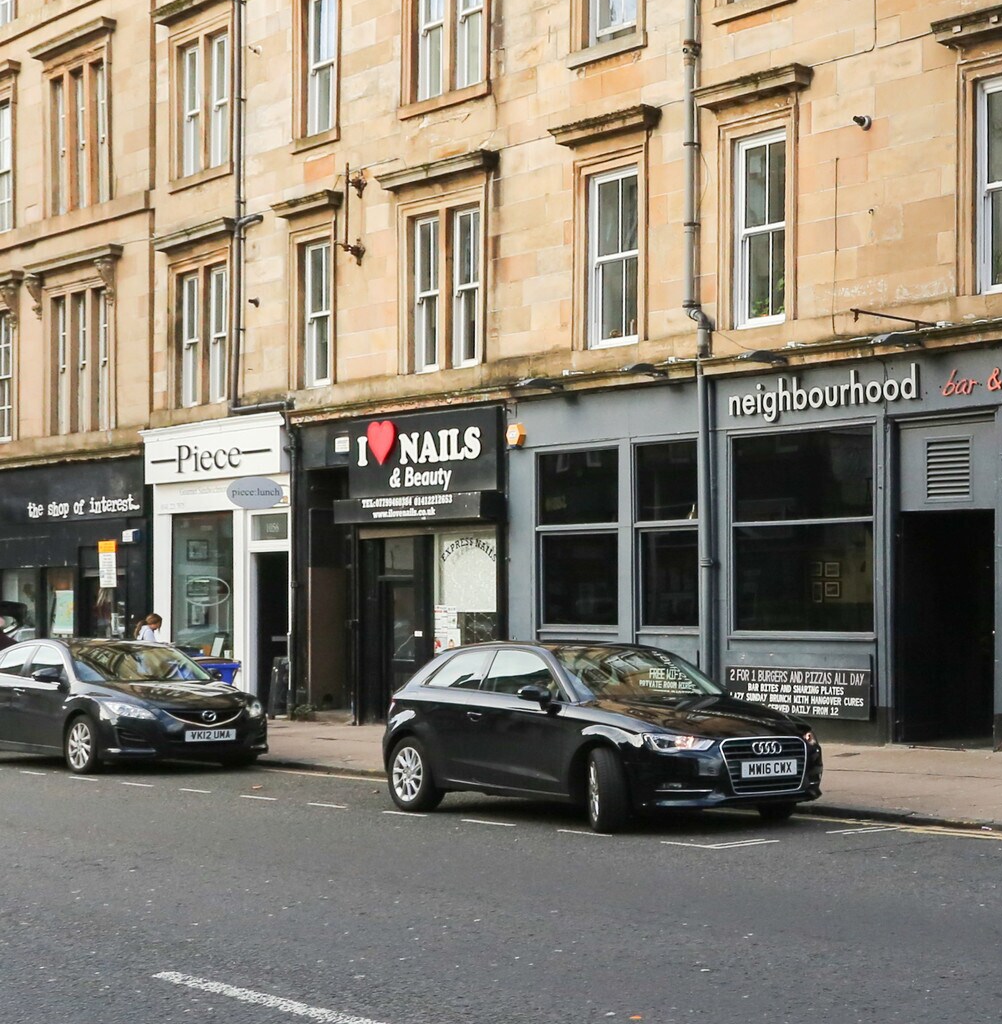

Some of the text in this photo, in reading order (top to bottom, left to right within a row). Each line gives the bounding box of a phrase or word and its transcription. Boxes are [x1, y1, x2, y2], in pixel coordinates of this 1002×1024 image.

[728, 363, 919, 422] neighbourhood
[941, 368, 979, 397] bar
[986, 367, 1002, 391] &
[357, 426, 482, 467] I NAILS
[175, 444, 241, 474] Piece
[389, 466, 453, 492] & Beauty
[231, 487, 280, 499] piece:lunch
[27, 502, 44, 518] the
[47, 501, 70, 519] shop
[73, 499, 86, 515] of
[440, 537, 496, 562] EXPRESS NAILS
[649, 667, 666, 680] FREE
[730, 669, 865, 686] 2 FOR 1 BURGERS AND PIZZAS ALL DAY
[747, 682, 844, 696] BAR BITES AND SHARING PLATES
[746, 692, 767, 702] SUNDAY
[769, 693, 792, 704] BRUNCH
[793, 695, 809, 705] WITH
[811, 695, 841, 706] HANGOVER
[844, 697, 864, 707] CURES
[791, 704, 811, 714] DAILY
[812, 706, 829, 716] FROM
[830, 707, 839, 716] 12
[190, 730, 231, 740] VK12 UMA
[748, 761, 792, 776] MW16 CWX
